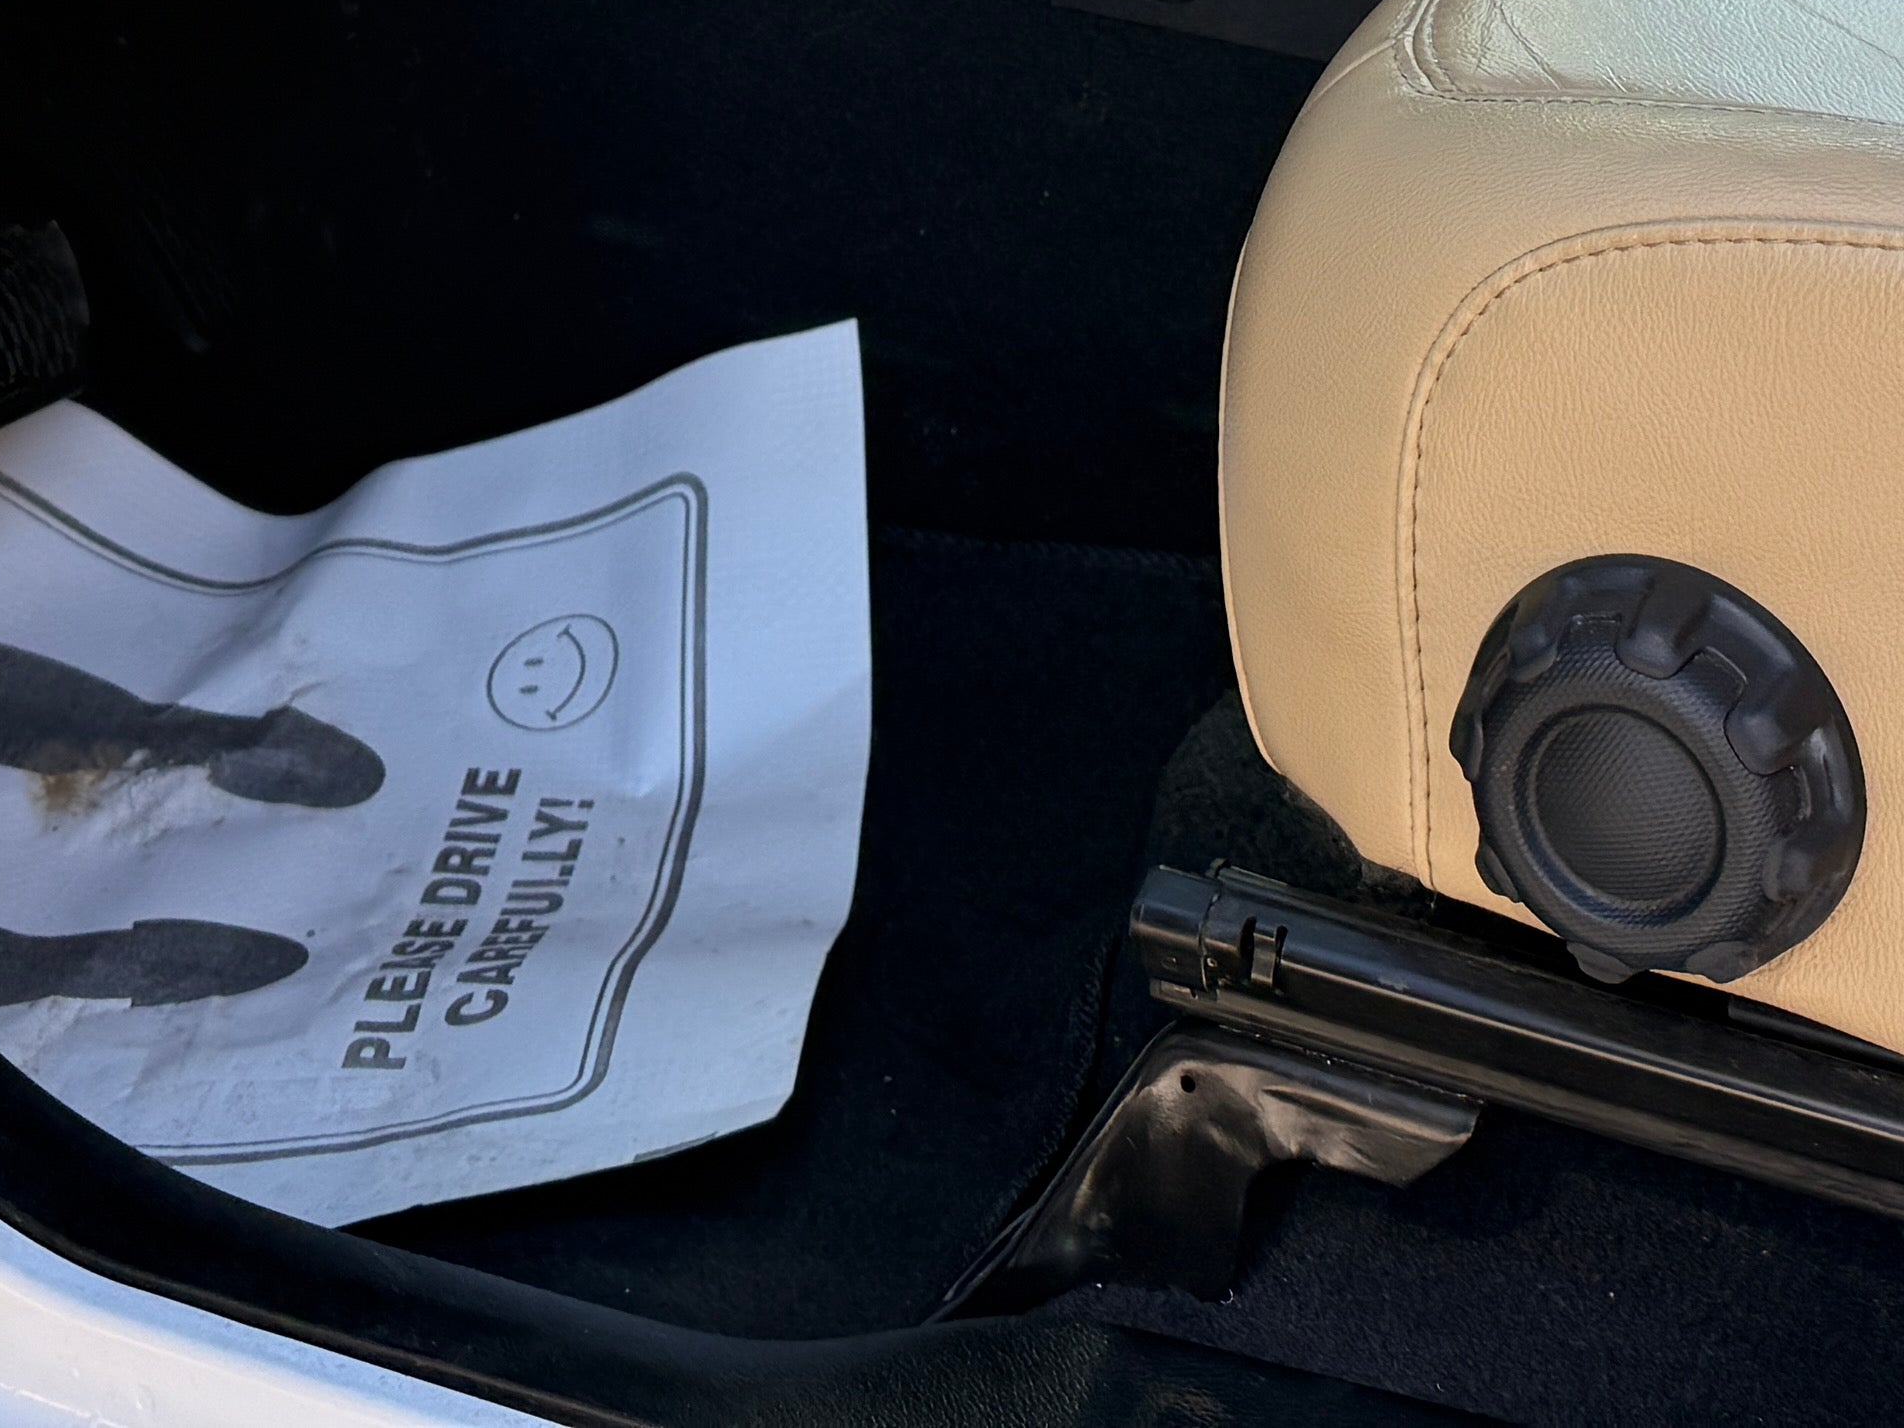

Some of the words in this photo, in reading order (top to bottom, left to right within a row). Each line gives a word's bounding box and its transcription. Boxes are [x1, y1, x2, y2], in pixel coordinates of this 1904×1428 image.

[341, 918, 469, 1070] PLEASE
[419, 767, 522, 905] DRIVE
[444, 797, 595, 1027] CAREFULLY!
